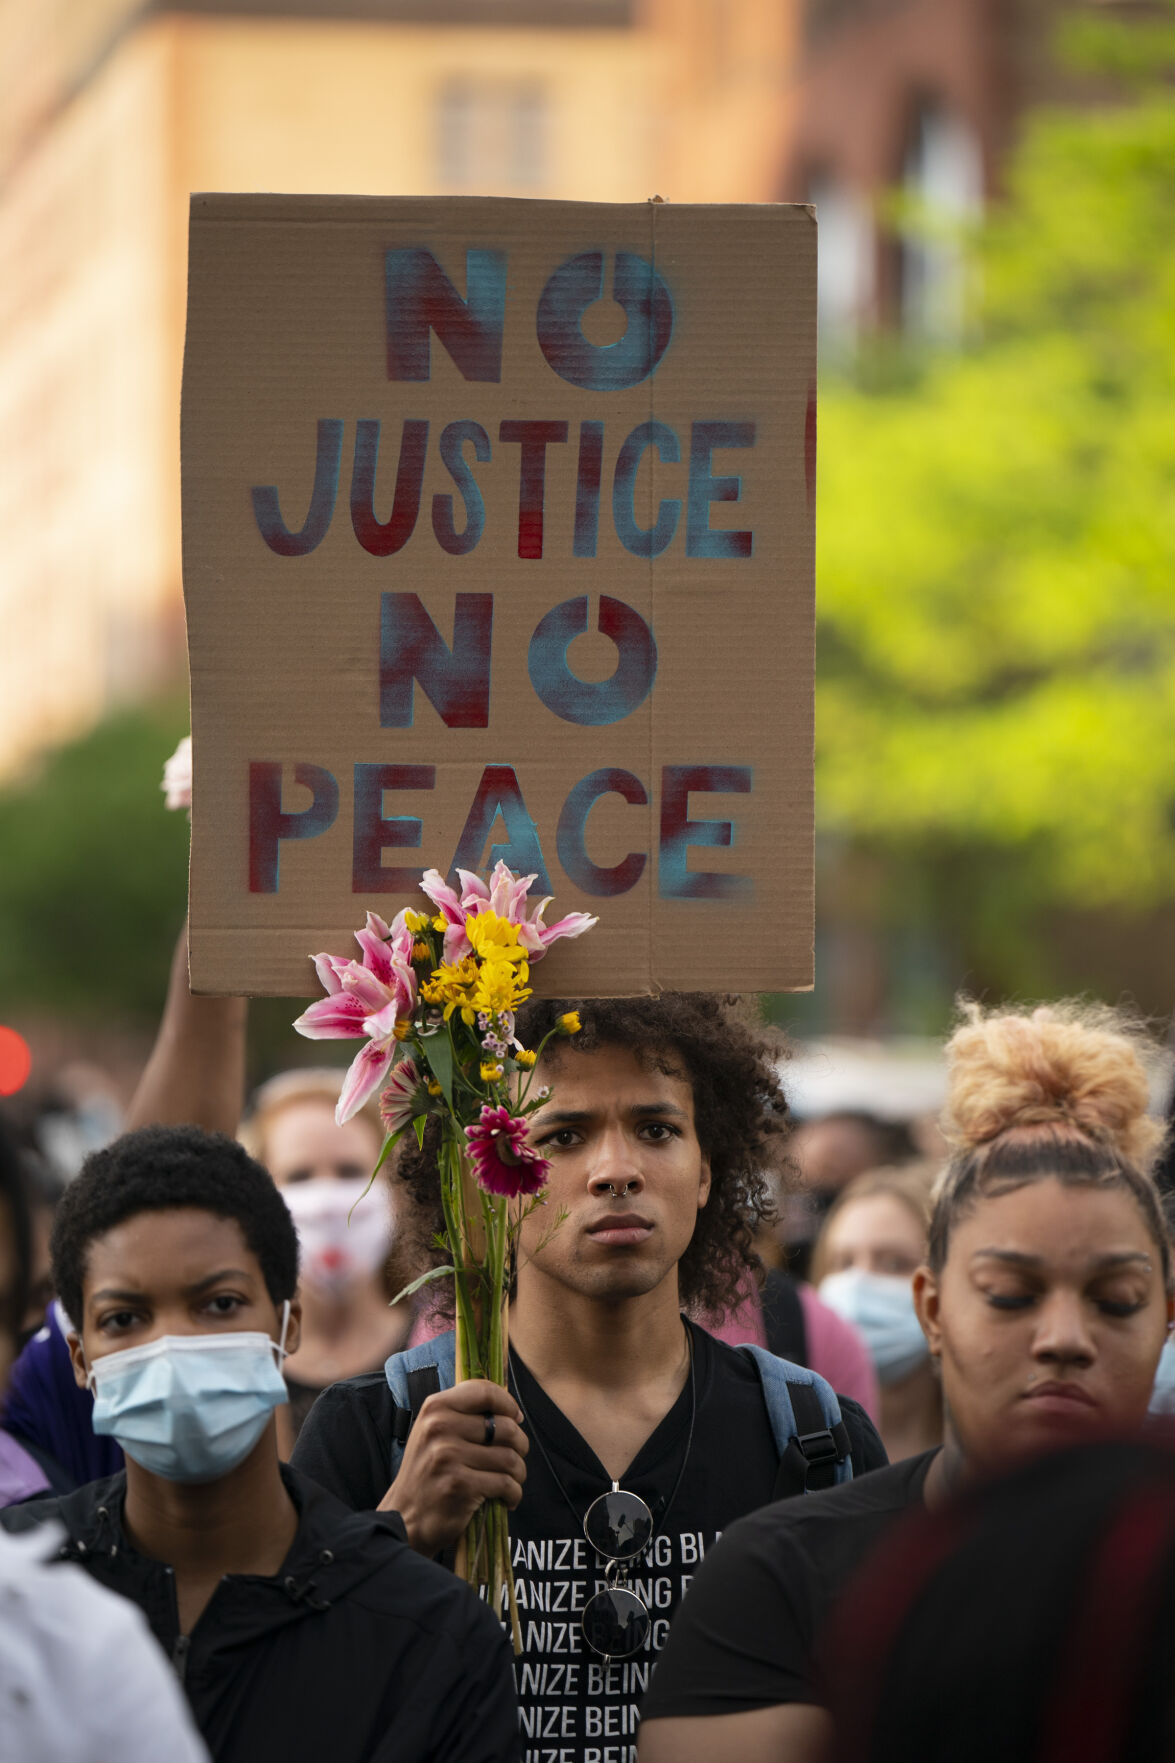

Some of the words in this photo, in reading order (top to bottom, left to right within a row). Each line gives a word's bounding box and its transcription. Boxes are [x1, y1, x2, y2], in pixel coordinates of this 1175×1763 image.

[384, 246, 676, 391] NO
[251, 418, 756, 559] JUSTICE
[380, 592, 658, 728] NO
[248, 762, 754, 899] PEACE
[507, 1536, 587, 1571] ANIZE
[587, 1662, 657, 1695] BEIN
